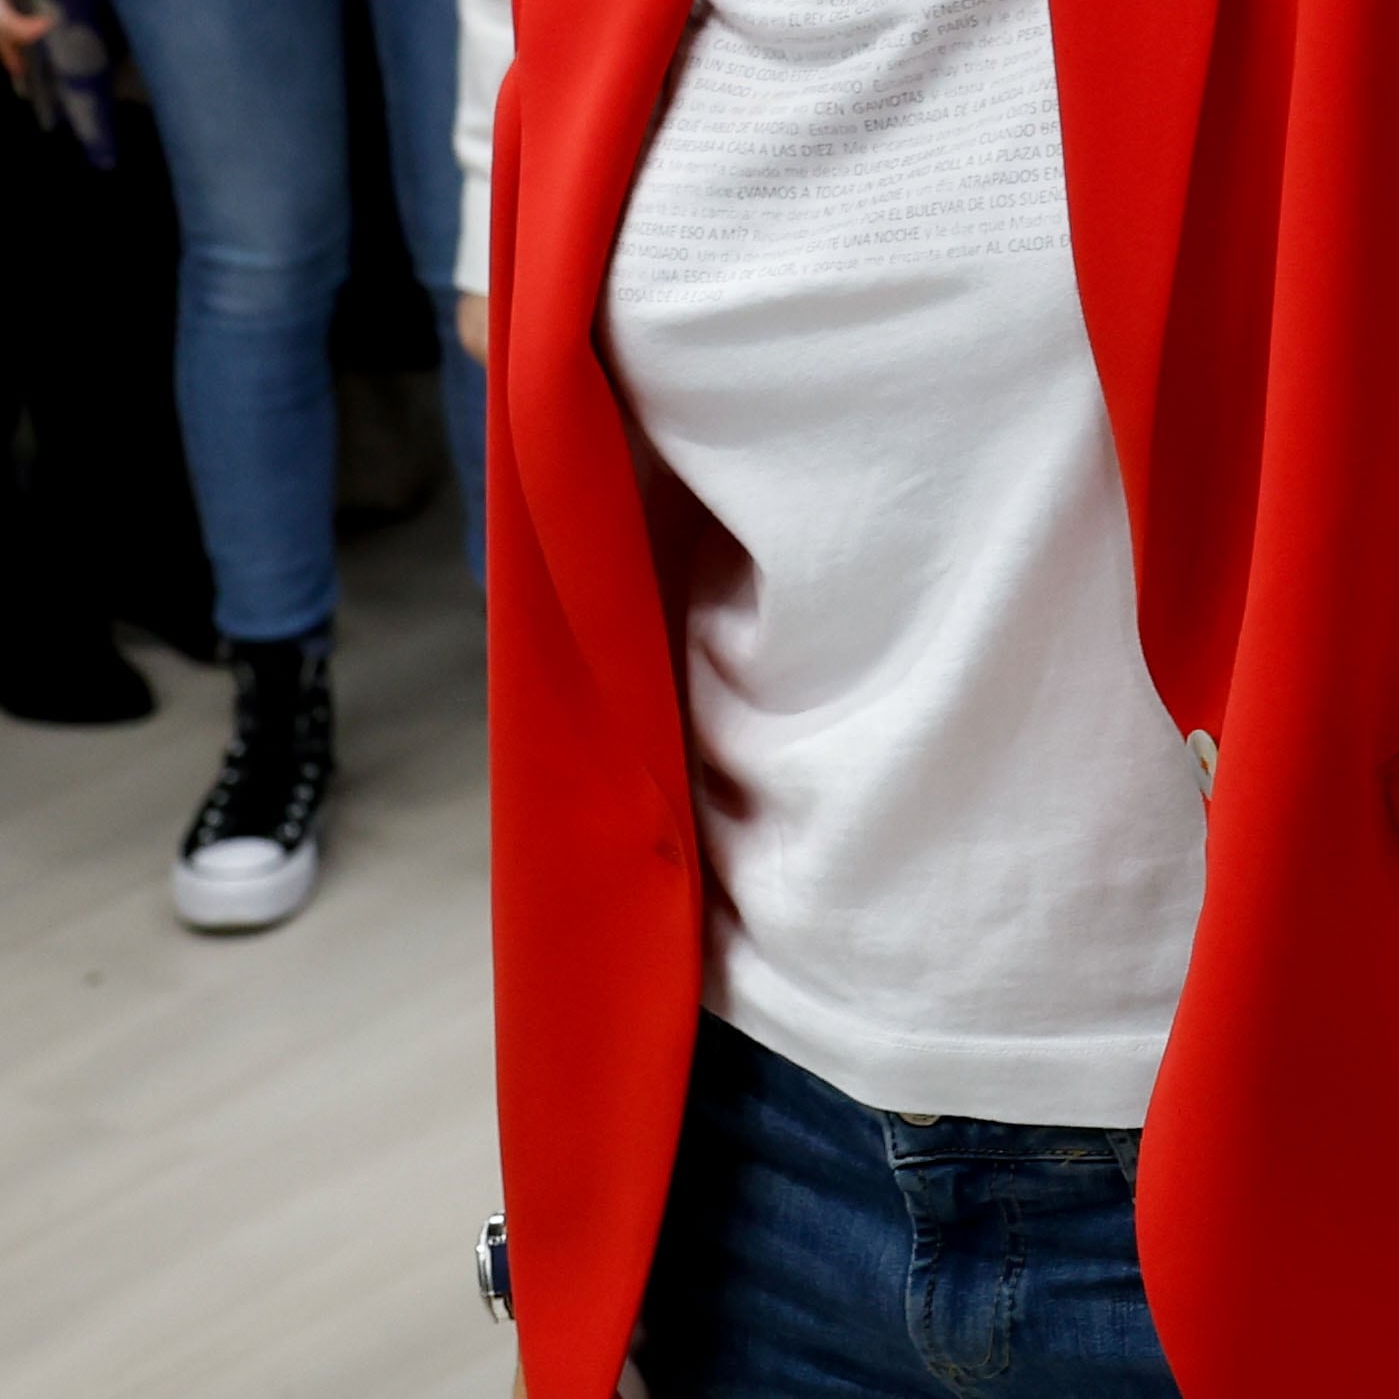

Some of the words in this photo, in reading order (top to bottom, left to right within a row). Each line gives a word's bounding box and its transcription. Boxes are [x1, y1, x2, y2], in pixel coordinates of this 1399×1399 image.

[851, 89, 926, 116] GAVIOTAS
[956, 167, 1040, 191] ATRAPADOS
[905, 198, 967, 219] BULEVAR
[989, 192, 1018, 210] LOS
[873, 225, 921, 245] NOCHE
